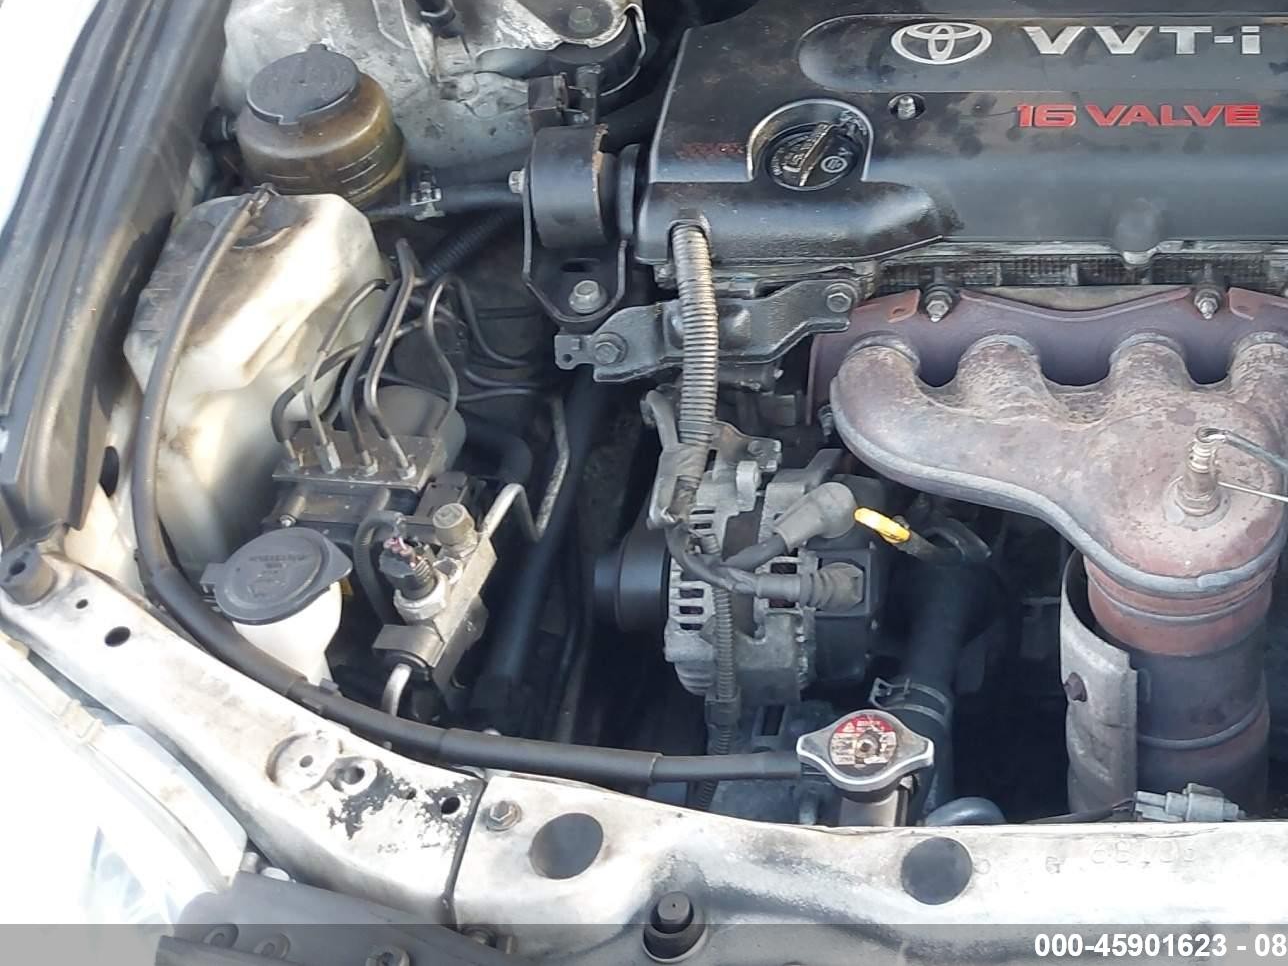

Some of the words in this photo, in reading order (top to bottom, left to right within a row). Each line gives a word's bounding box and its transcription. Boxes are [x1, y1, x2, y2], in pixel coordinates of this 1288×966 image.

[1023, 26, 1261, 55] VVT-i
[1017, 104, 1077, 128] 16
[1084, 103, 1262, 128] VALVE
